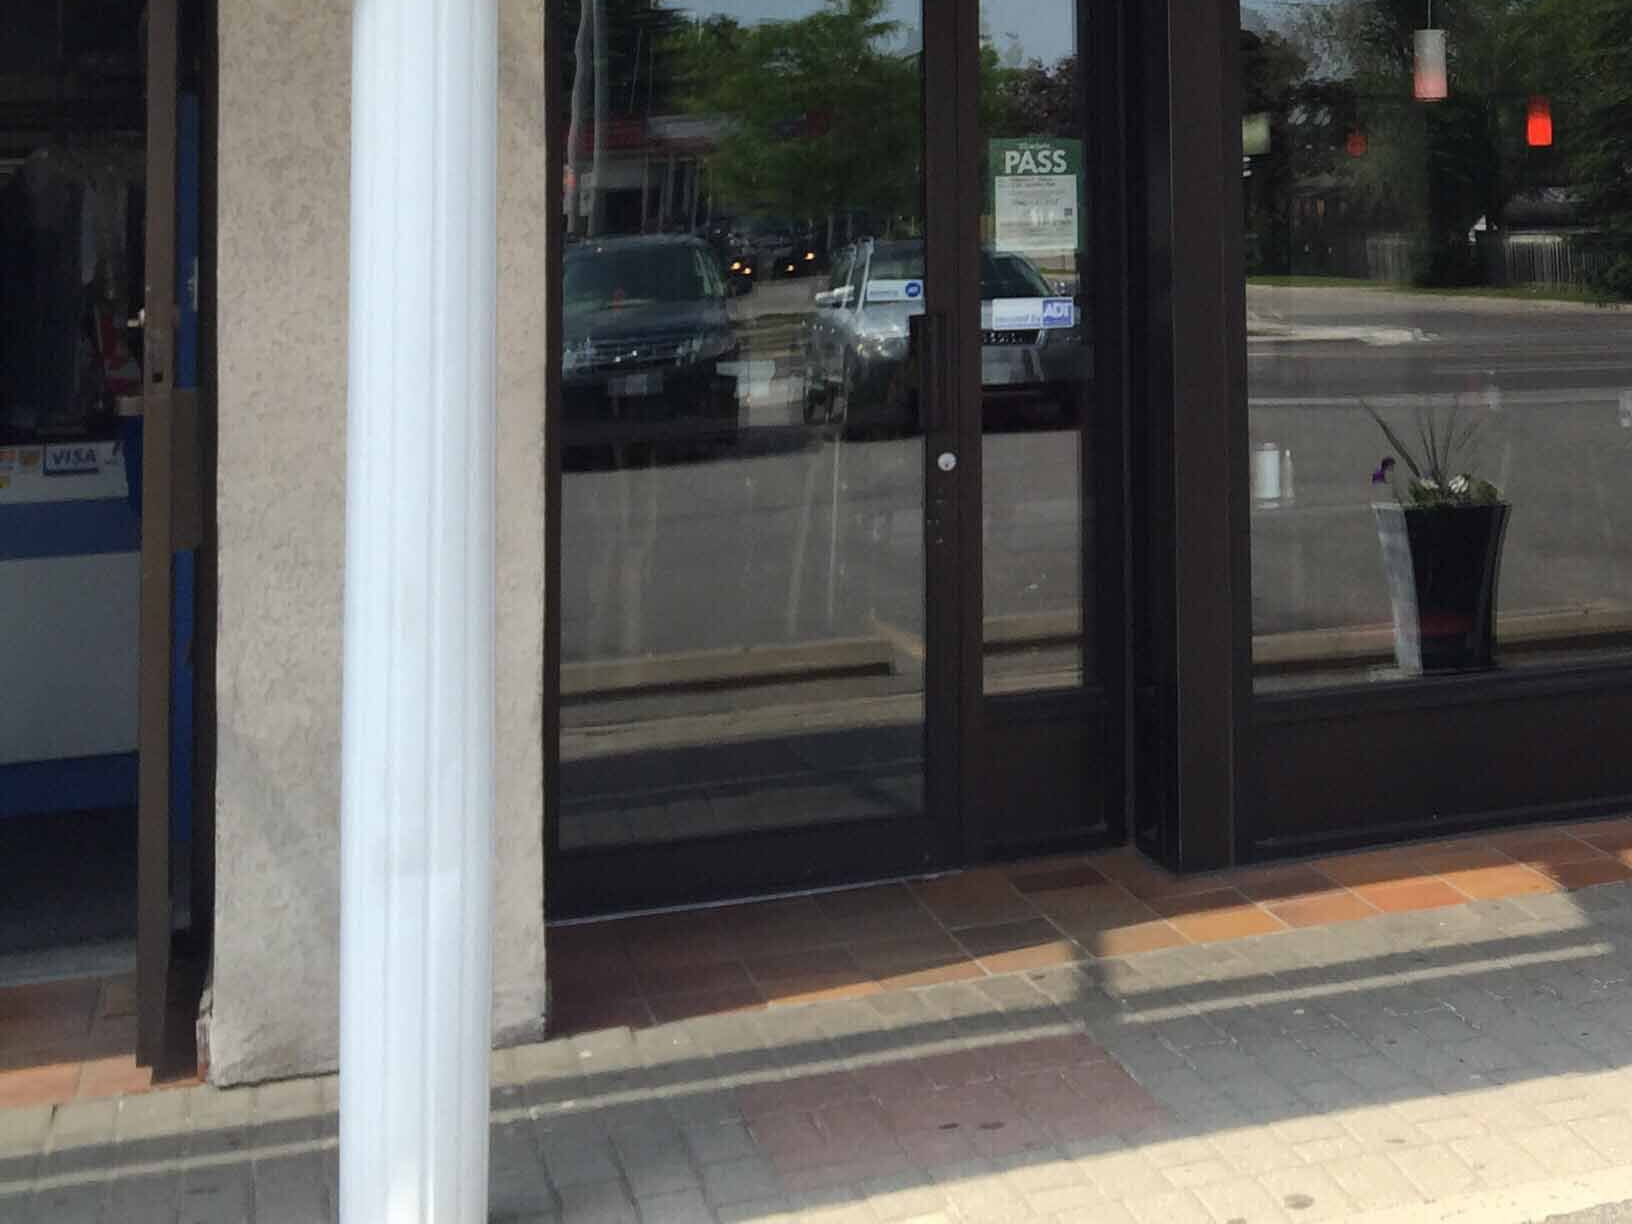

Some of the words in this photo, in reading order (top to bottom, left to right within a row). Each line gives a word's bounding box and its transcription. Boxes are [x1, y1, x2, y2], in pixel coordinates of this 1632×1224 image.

[1004, 150, 1067, 174] PASS
[1044, 302, 1072, 319] ADT
[51, 447, 96, 465] VISA
